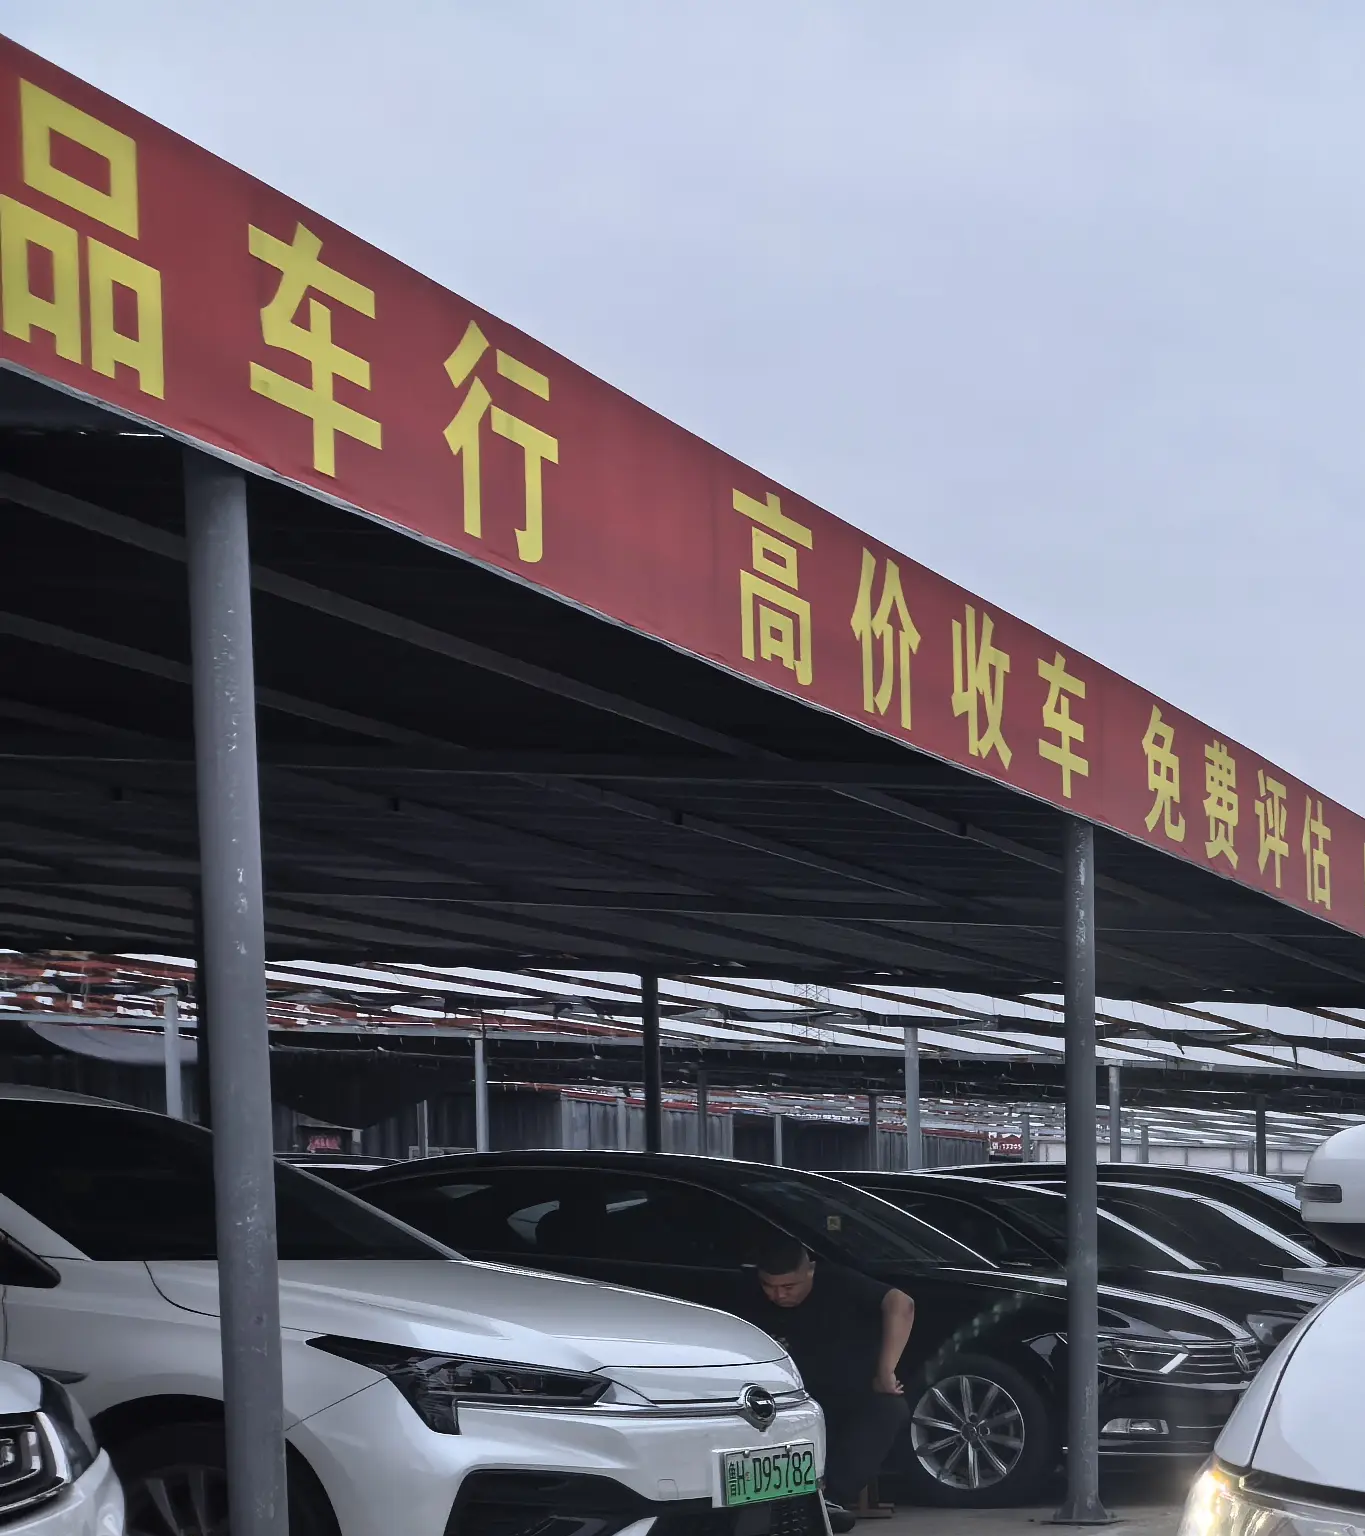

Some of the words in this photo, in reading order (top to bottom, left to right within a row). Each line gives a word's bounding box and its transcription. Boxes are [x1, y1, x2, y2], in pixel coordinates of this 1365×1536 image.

[0, 76, 559, 564] 品车行
[732, 486, 1089, 799] 高价收车
[1141, 703, 1334, 911] 免费评估
